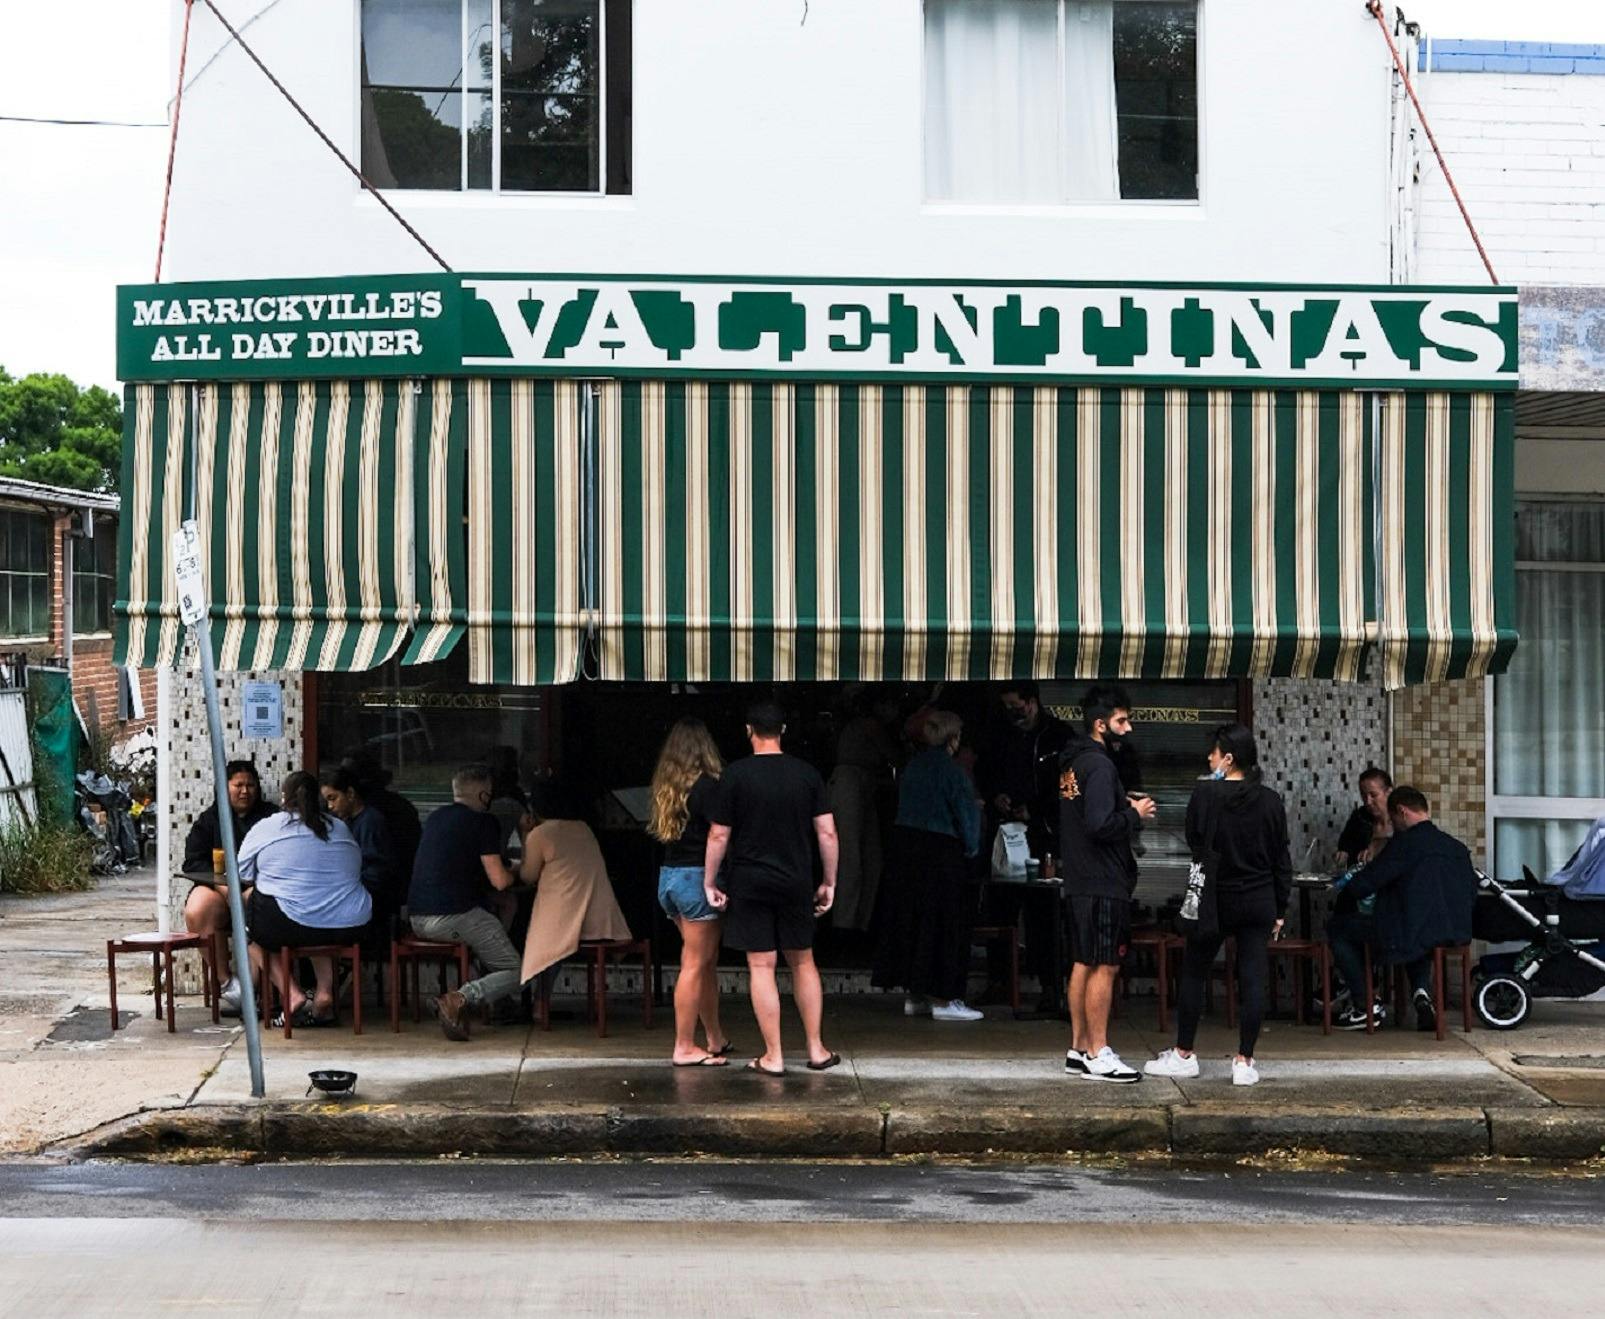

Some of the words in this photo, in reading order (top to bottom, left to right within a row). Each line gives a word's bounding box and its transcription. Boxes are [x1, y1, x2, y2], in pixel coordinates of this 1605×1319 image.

[132, 291, 443, 326] MARRICKVILLE'S
[151, 333, 221, 361] ALL
[231, 332, 298, 359] DAY
[307, 329, 423, 358] DINER
[475, 280, 1507, 379] VALENTINAS
